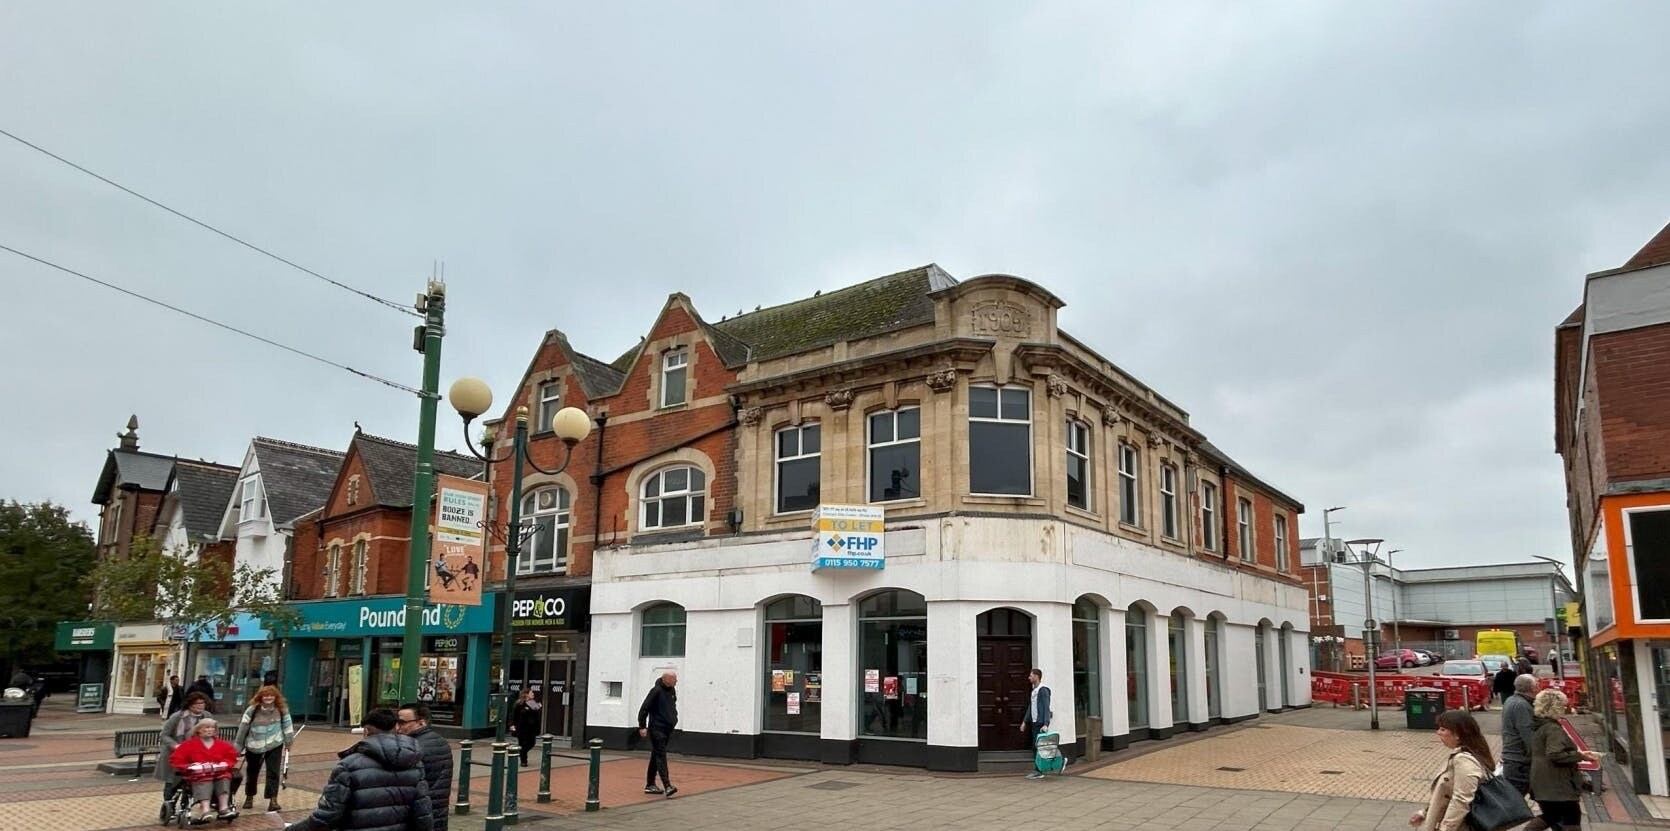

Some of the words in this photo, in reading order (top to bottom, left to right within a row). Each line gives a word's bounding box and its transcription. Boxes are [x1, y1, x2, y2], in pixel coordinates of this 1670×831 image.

[442, 505, 466, 515] BOOZE
[467, 509, 474, 517] IS
[832, 520, 847, 530] TO
[852, 520, 872, 531] LET
[847, 537, 878, 550] FHP
[825, 559, 841, 567] 0115
[860, 560, 879, 569] 7577
[360, 603, 441, 628] Poundnd
